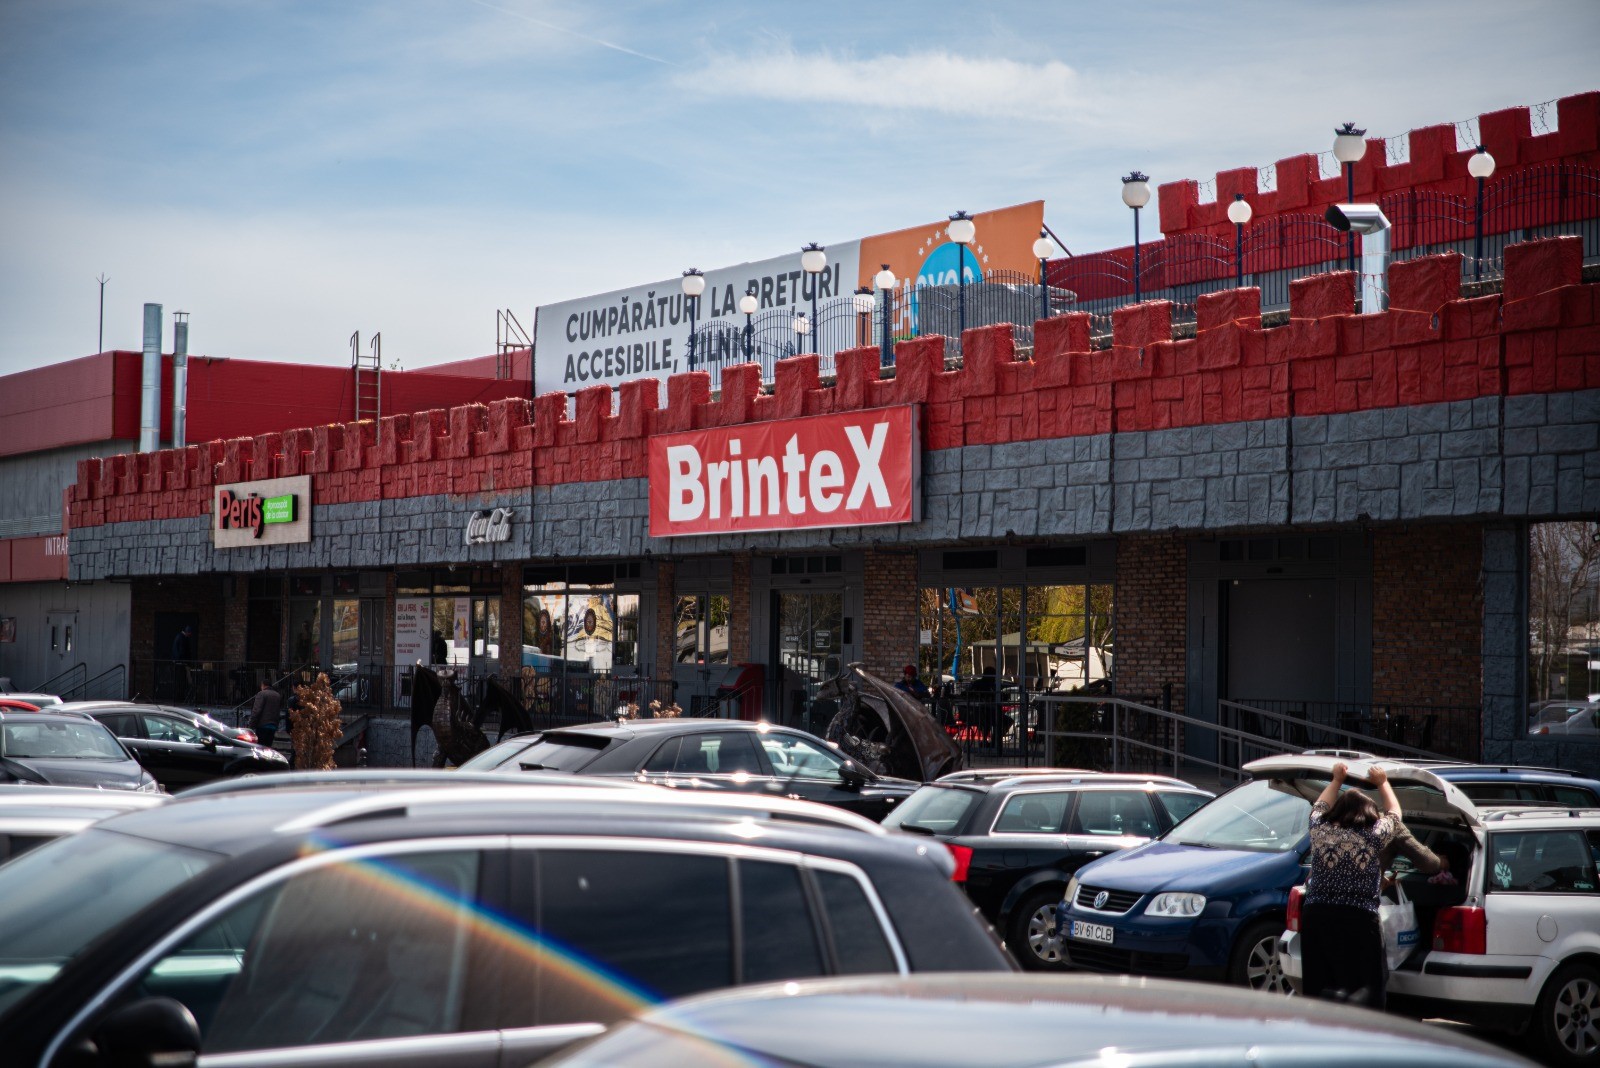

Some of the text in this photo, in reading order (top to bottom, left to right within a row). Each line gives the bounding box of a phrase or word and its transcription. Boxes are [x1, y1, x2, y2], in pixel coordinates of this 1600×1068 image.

[565, 290, 701, 343] CUMPĂRĂTURI
[710, 283, 737, 318] LA
[563, 337, 679, 384] ACCESIBILE,
[666, 421, 893, 523] BrinteX
[1074, 922, 1112, 942] BV 61 CLB
